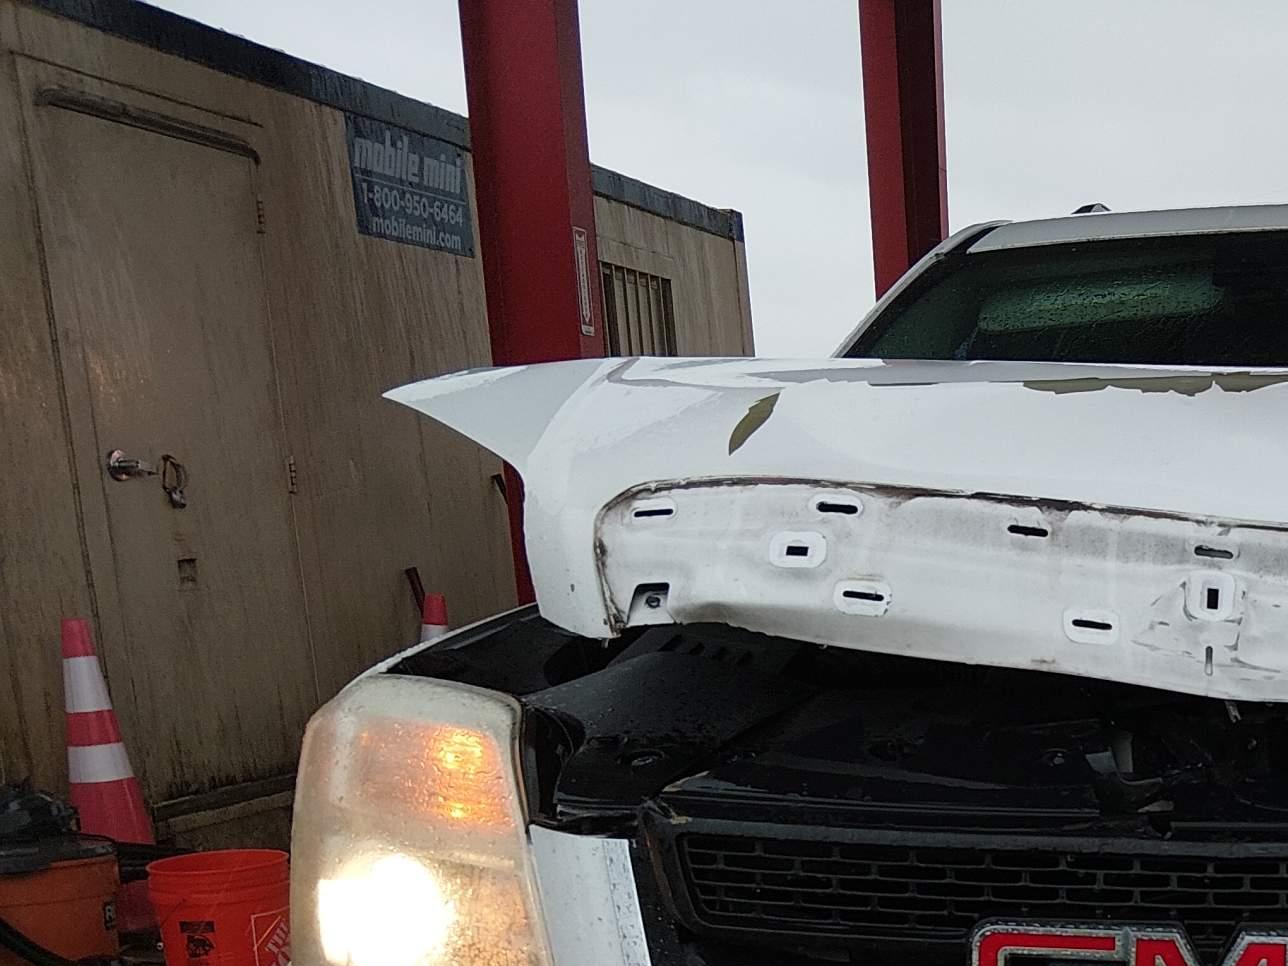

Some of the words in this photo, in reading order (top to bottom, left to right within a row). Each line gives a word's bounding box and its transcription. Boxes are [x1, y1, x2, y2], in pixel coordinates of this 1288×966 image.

[353, 130, 420, 183] mobile
[423, 154, 462, 194] mini
[361, 182, 463, 226] 1-800-950-6464
[372, 216, 462, 250] mobilemini.com
